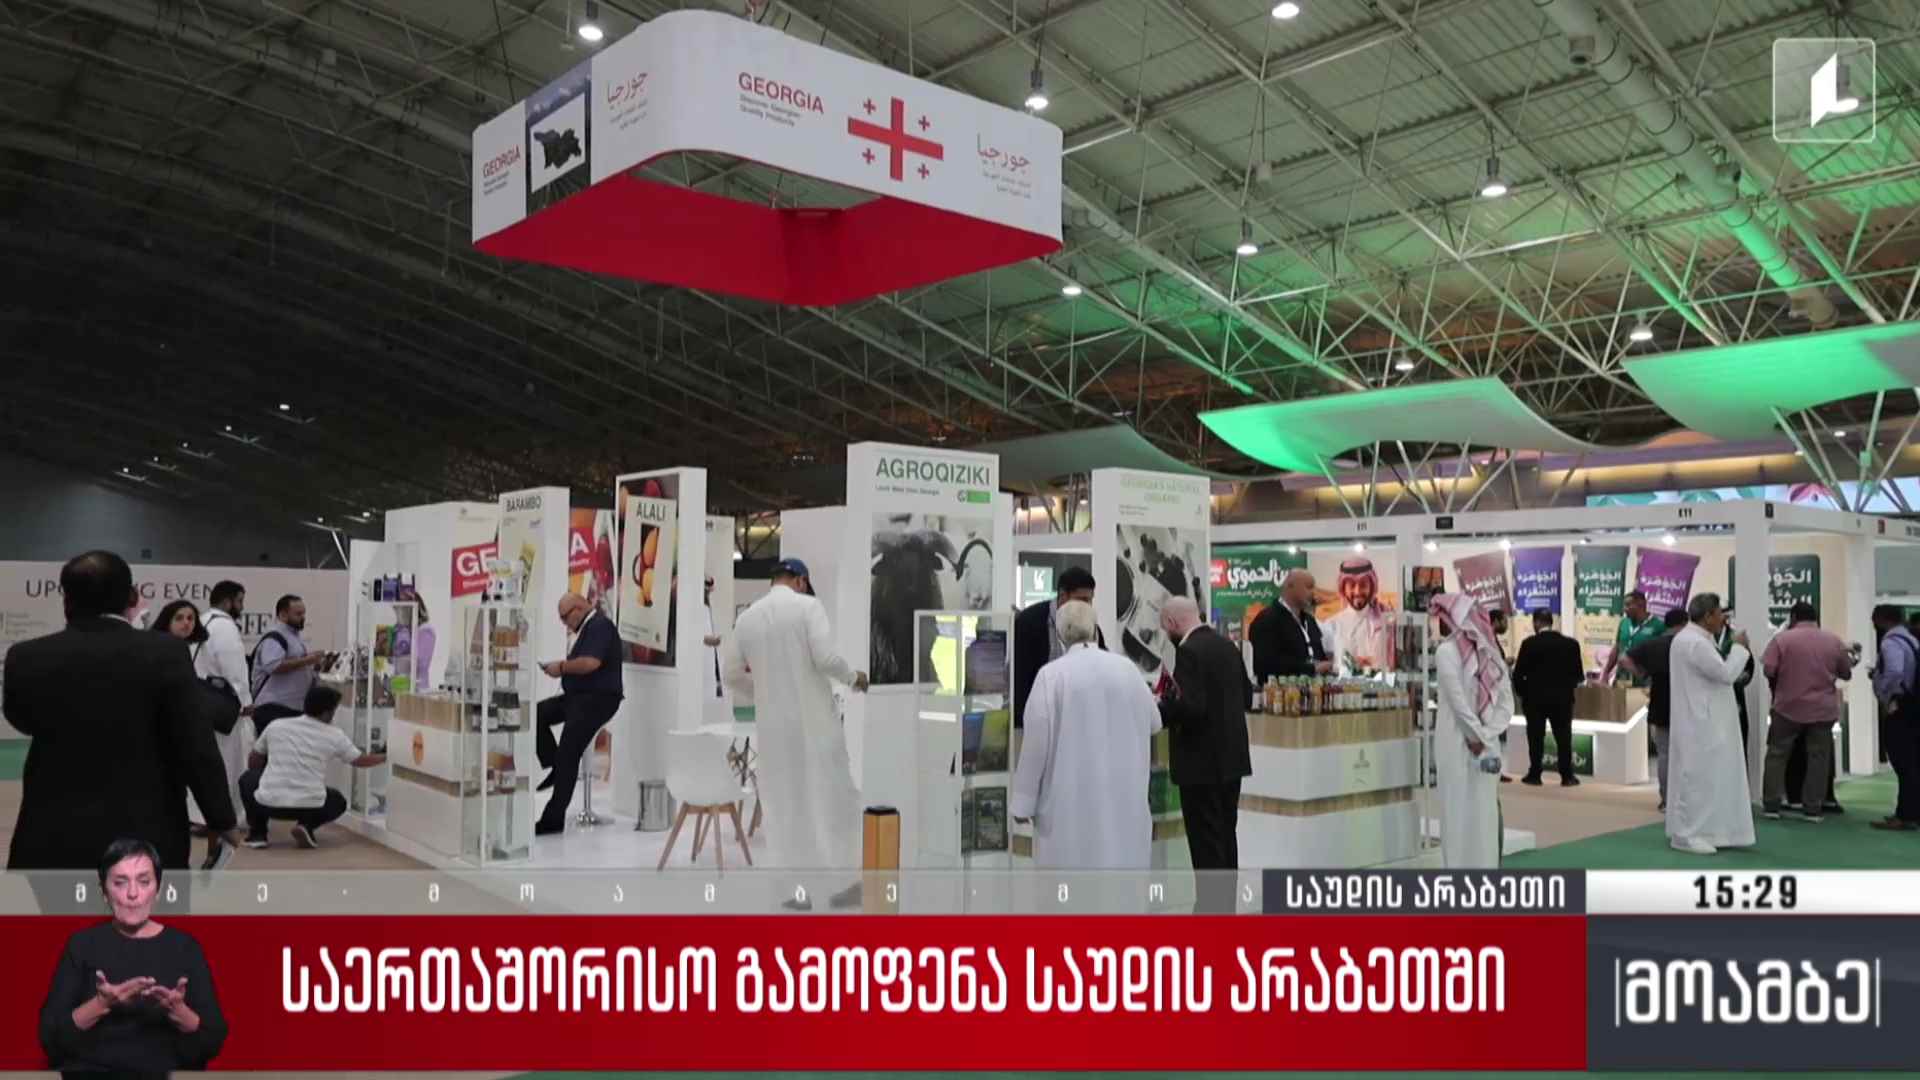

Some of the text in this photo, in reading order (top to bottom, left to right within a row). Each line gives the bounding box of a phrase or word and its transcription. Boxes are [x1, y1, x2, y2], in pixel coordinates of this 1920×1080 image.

[738, 71, 825, 115] GEORGIA
[482, 144, 521, 179] GEORGIA
[976, 131, 1031, 174] جورجيا
[876, 457, 990, 486] AGROQIZIKI
[506, 496, 542, 512] BARAMBO
[636, 503, 667, 521] ALALI
